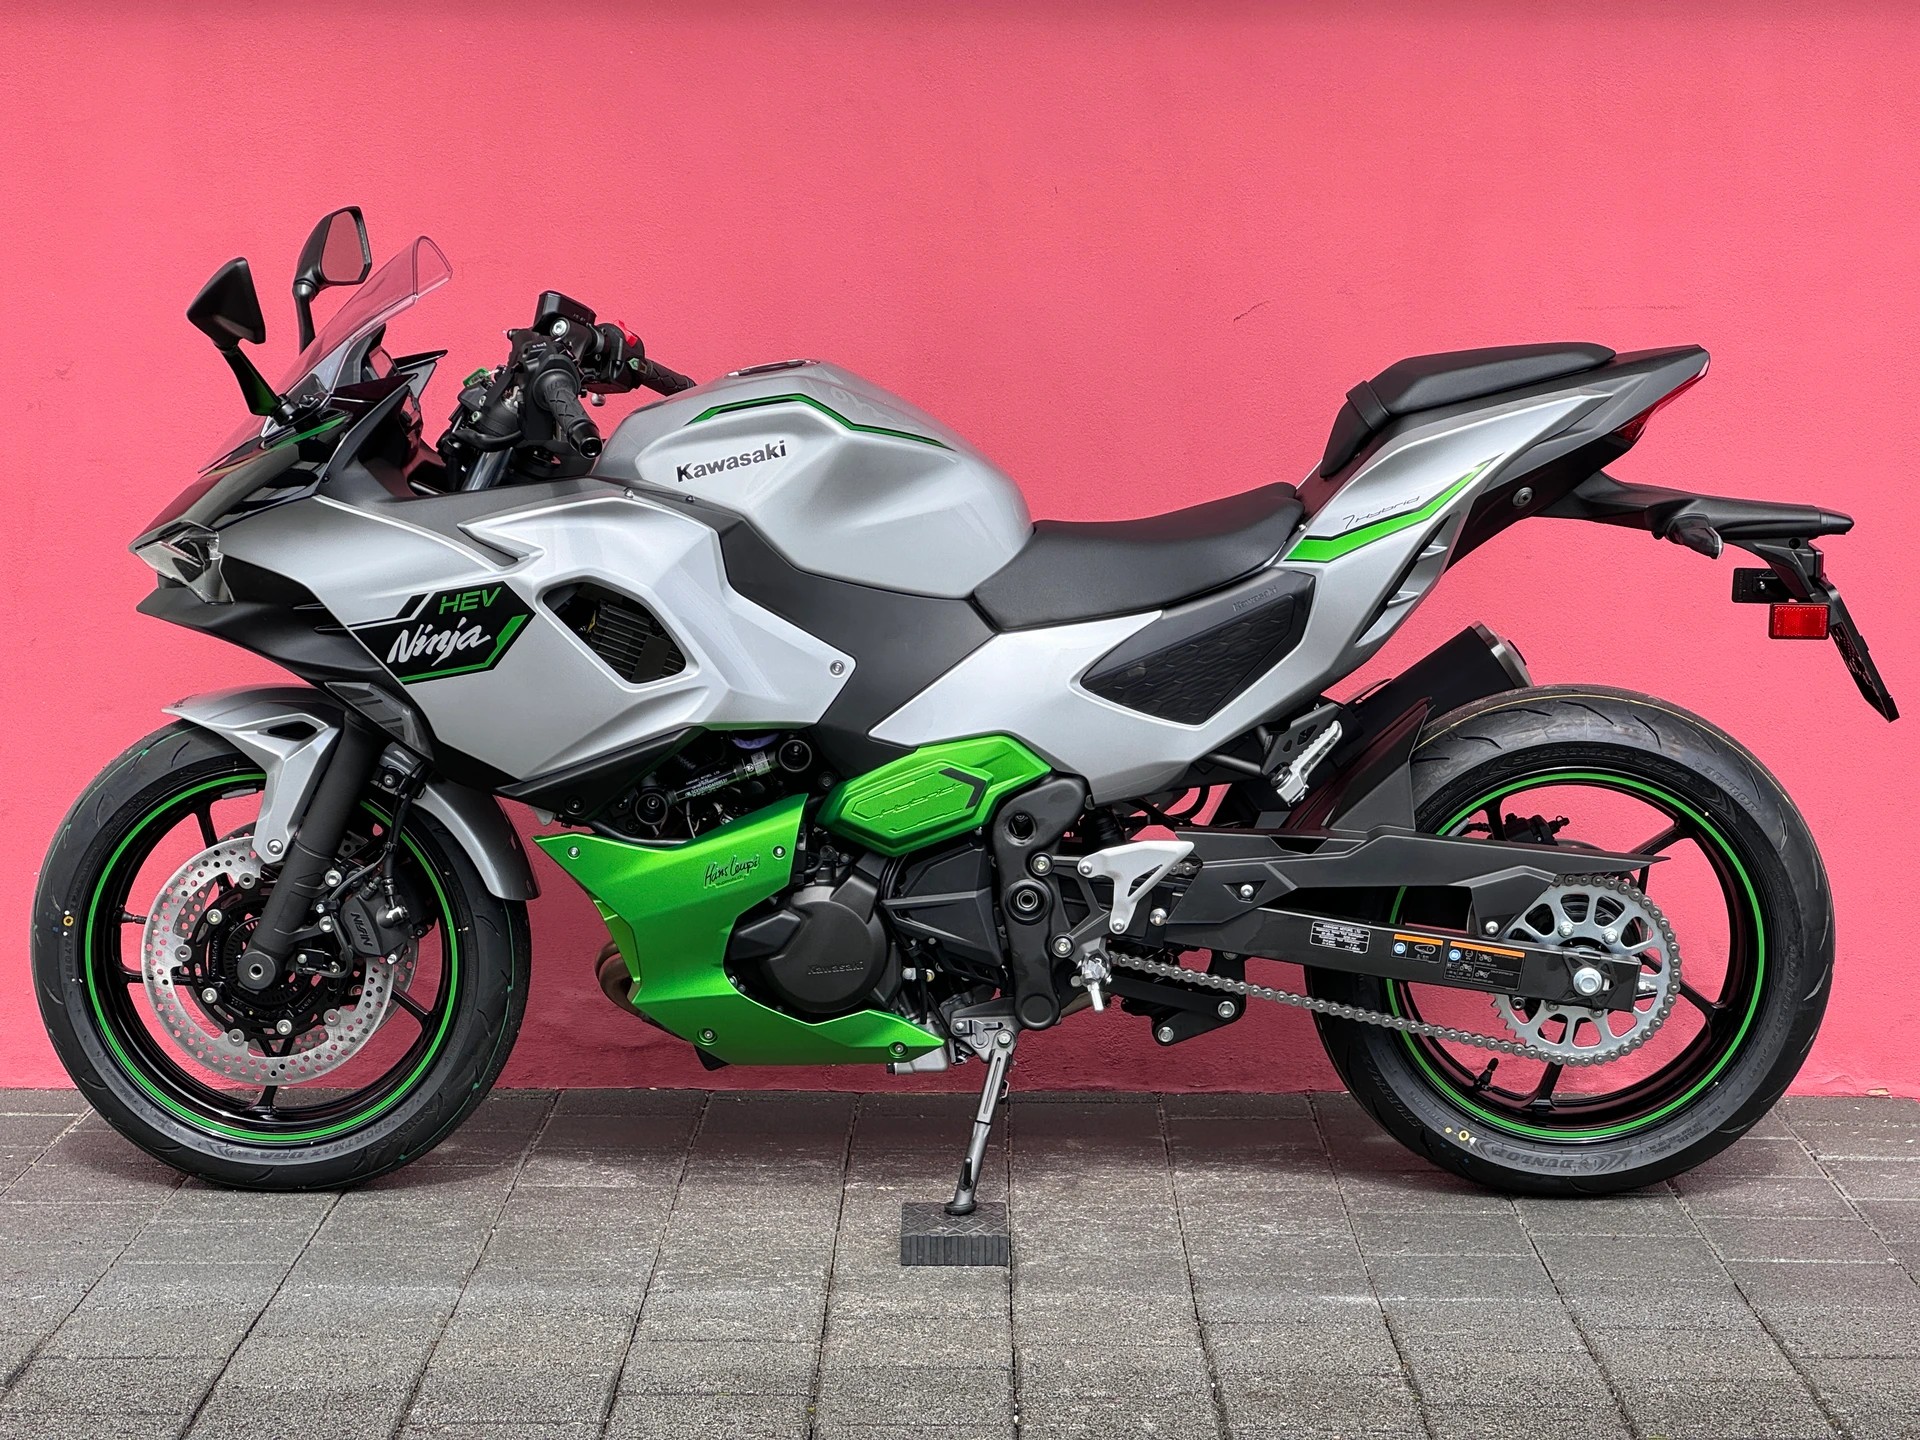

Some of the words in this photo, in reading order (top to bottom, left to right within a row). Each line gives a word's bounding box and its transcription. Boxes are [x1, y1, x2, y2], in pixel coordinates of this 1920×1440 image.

[676, 439, 787, 482] Kawasaki
[439, 586, 502, 615] HEV
[386, 616, 491, 667] Ninja
[1701, 762, 1759, 814] DUNLOP
[704, 861, 728, 888] Hans
[350, 911, 374, 947] NISSIN
[309, 1117, 392, 1159] SPORTMAX
[1489, 1142, 1574, 1171] DUNLOP
